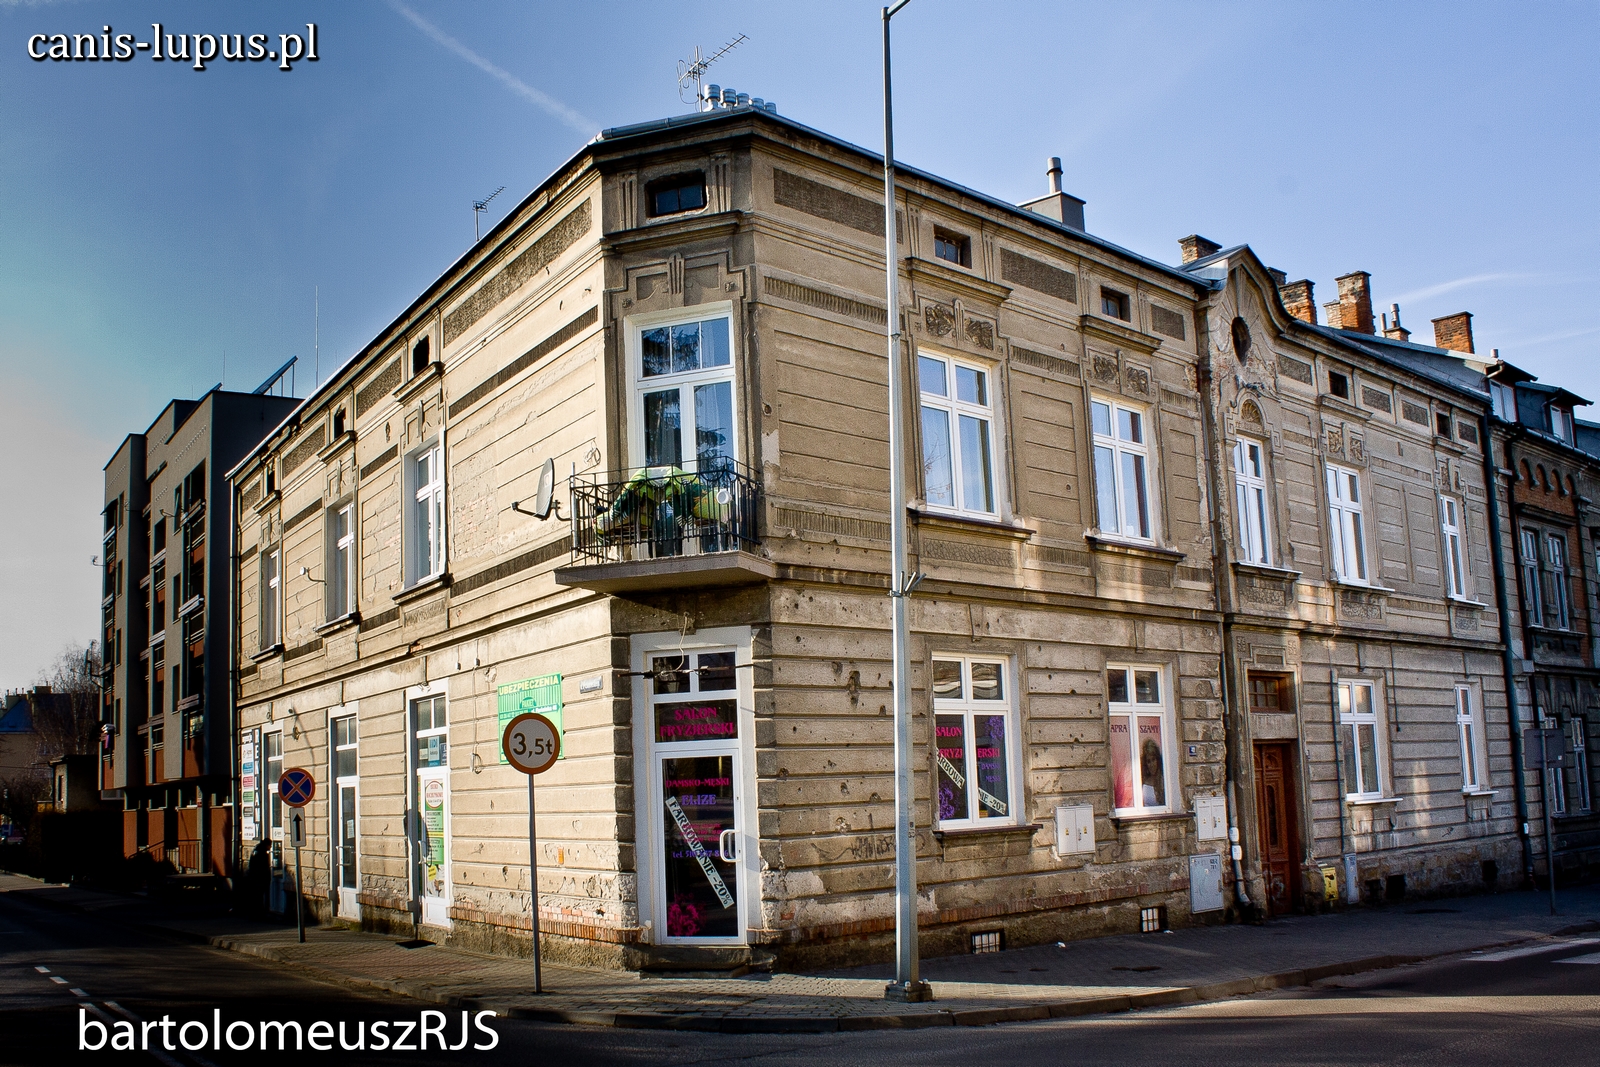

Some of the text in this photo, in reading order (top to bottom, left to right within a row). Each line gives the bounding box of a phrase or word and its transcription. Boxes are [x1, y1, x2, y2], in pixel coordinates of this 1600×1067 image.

[498, 675, 560, 696] UBEZPIECZENIA
[674, 707, 717, 721] SALON
[660, 722, 734, 737] FRYZJERSKI
[936, 727, 962, 737] SALON
[512, 732, 553, 759] 3,5t
[666, 777, 730, 788] DAMSKO-MĘSKI
[681, 793, 717, 806] ELIZE
[668, 800, 716, 877] FARBOWANIE
[713, 876, 733, 905] -20%
